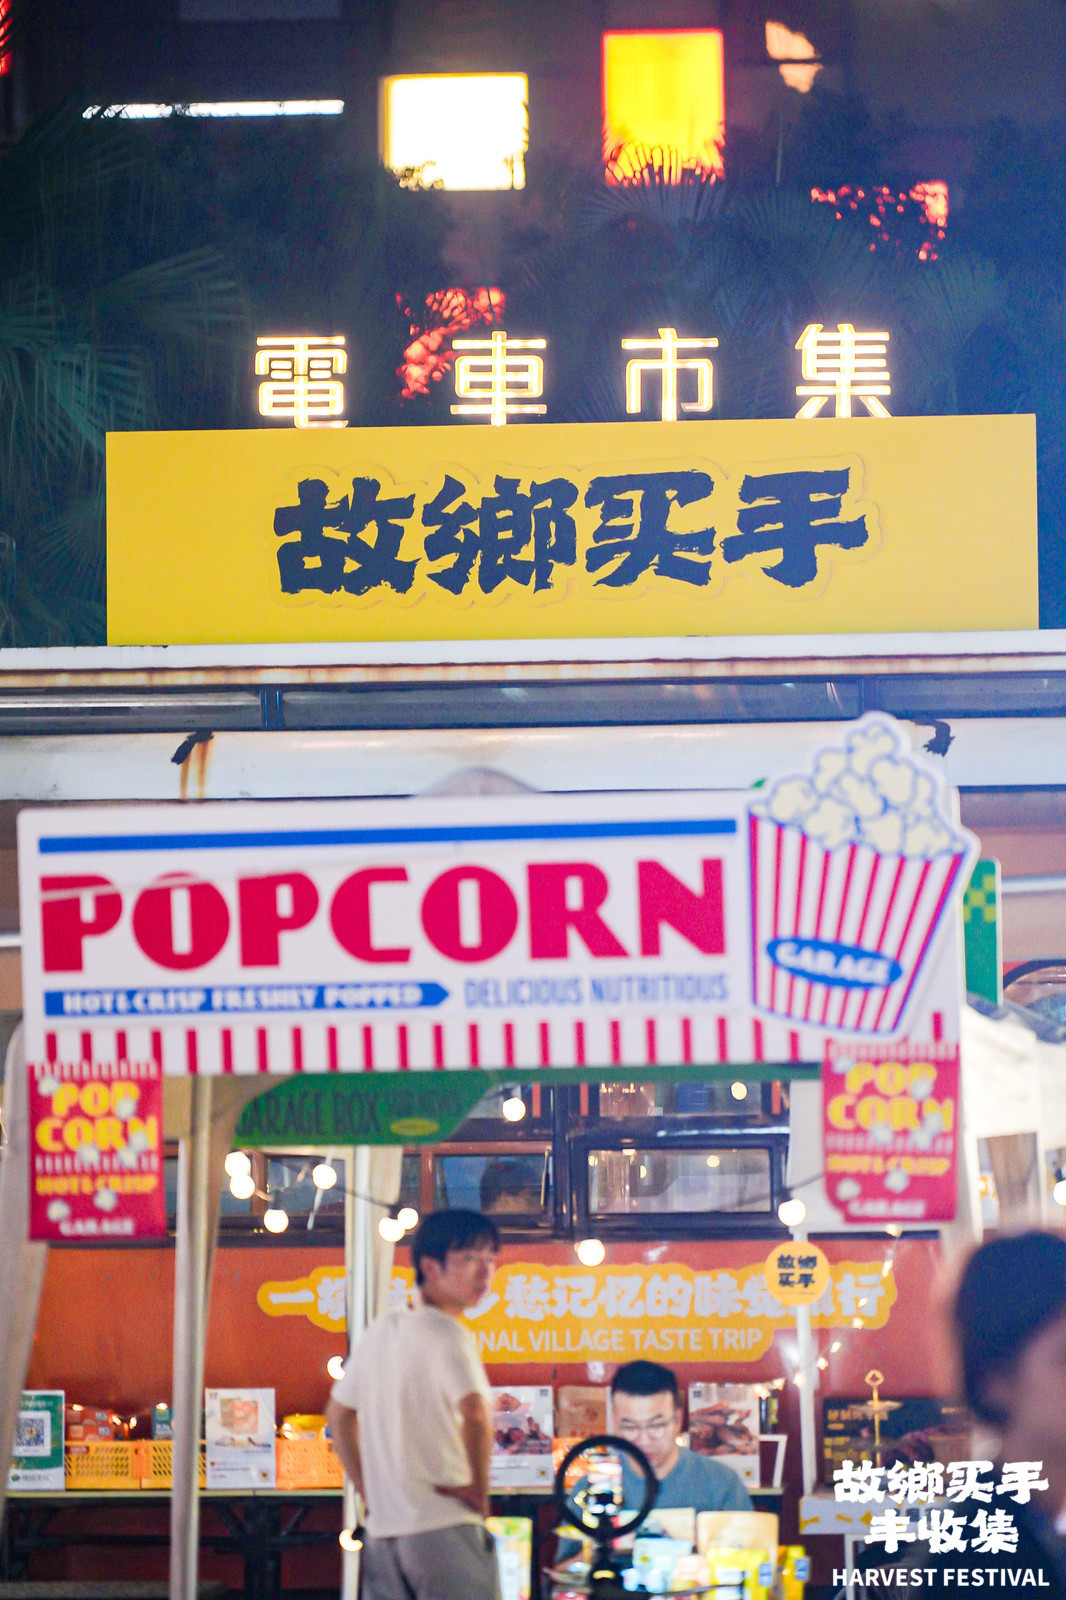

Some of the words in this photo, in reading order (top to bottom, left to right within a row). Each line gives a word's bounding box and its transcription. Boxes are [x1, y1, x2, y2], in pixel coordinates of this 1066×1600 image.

[255, 322, 893, 429] 電車市集
[274, 468, 868, 594] 故鄉买手
[40, 857, 728, 973] POPCORN
[775, 940, 890, 986] GARAGE
[324, 985, 423, 1008] POPPED
[465, 977, 584, 1009] DELICIOUS
[589, 973, 729, 1005] NUTRITIOUS
[845, 1062, 937, 1098] POP
[52, 1081, 141, 1118] POP
[828, 1094, 954, 1132] CORN
[35, 1115, 158, 1153] CORN
[528, 1330, 624, 1351] VILLAGE
[630, 1329, 703, 1351] TASTE
[708, 1328, 763, 1350] TRIP
